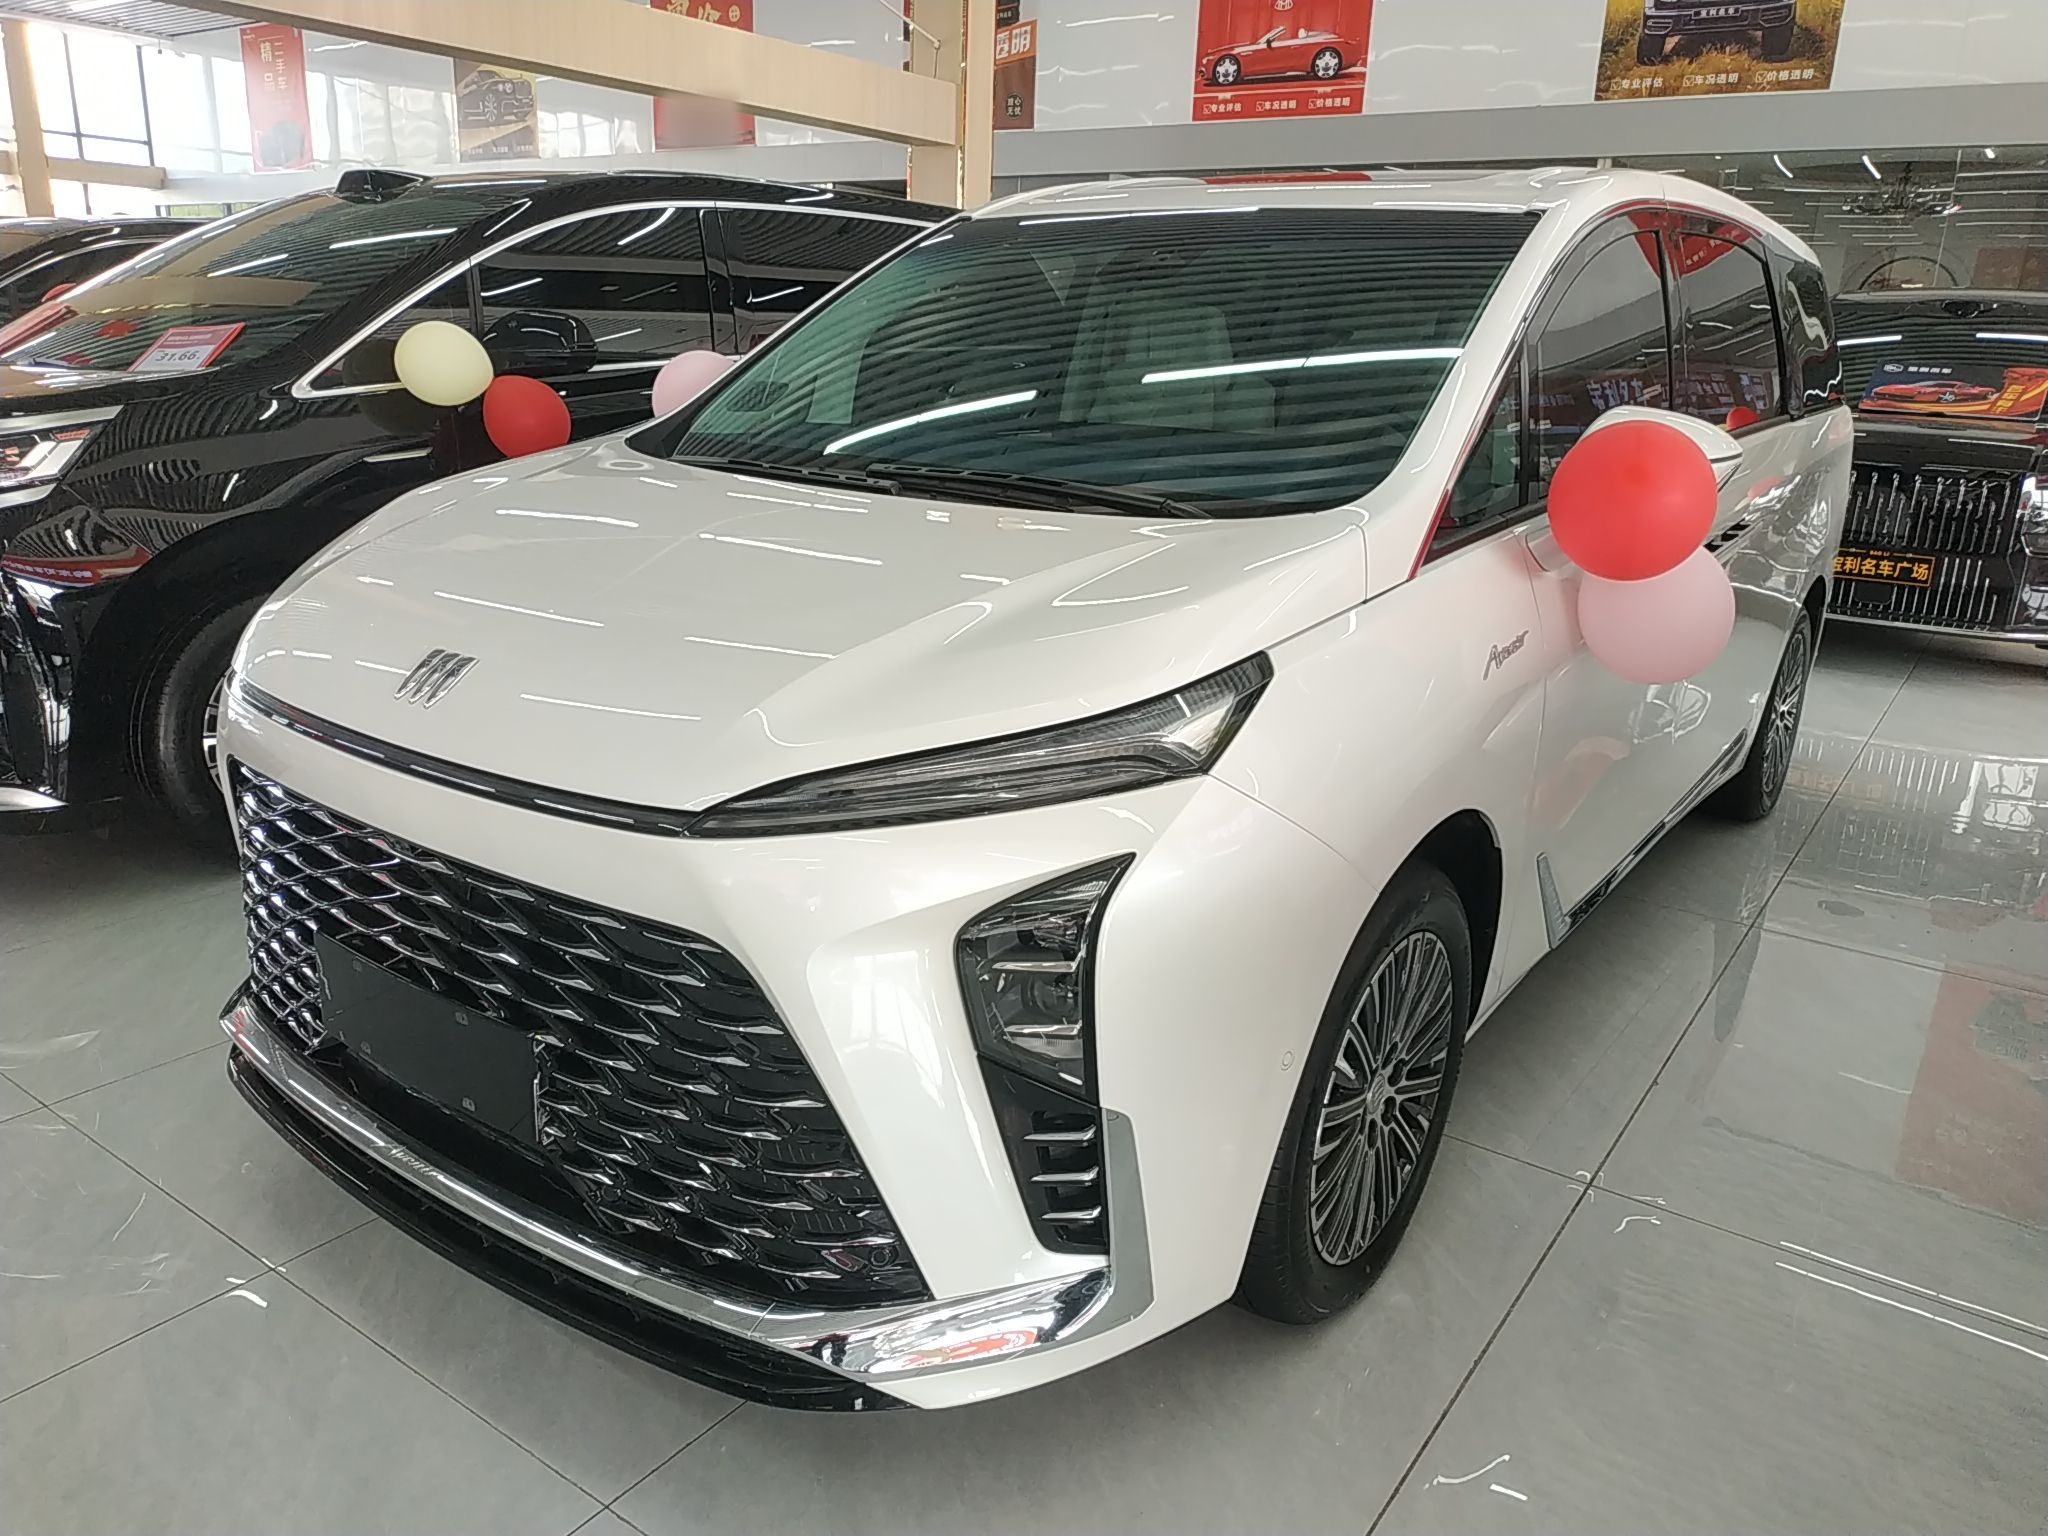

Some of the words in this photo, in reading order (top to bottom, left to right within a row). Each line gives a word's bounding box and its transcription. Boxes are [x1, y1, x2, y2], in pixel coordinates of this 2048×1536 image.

[274, 41, 288, 90] 二手车
[1621, 77, 1663, 89] 专业评估
[1693, 73, 1739, 86] 车况透明
[1766, 68, 1815, 82] 价格透明
[1210, 103, 1242, 113] 专业评估
[1263, 100, 1297, 110] 车况透明
[1316, 97, 1351, 108] 价格透明
